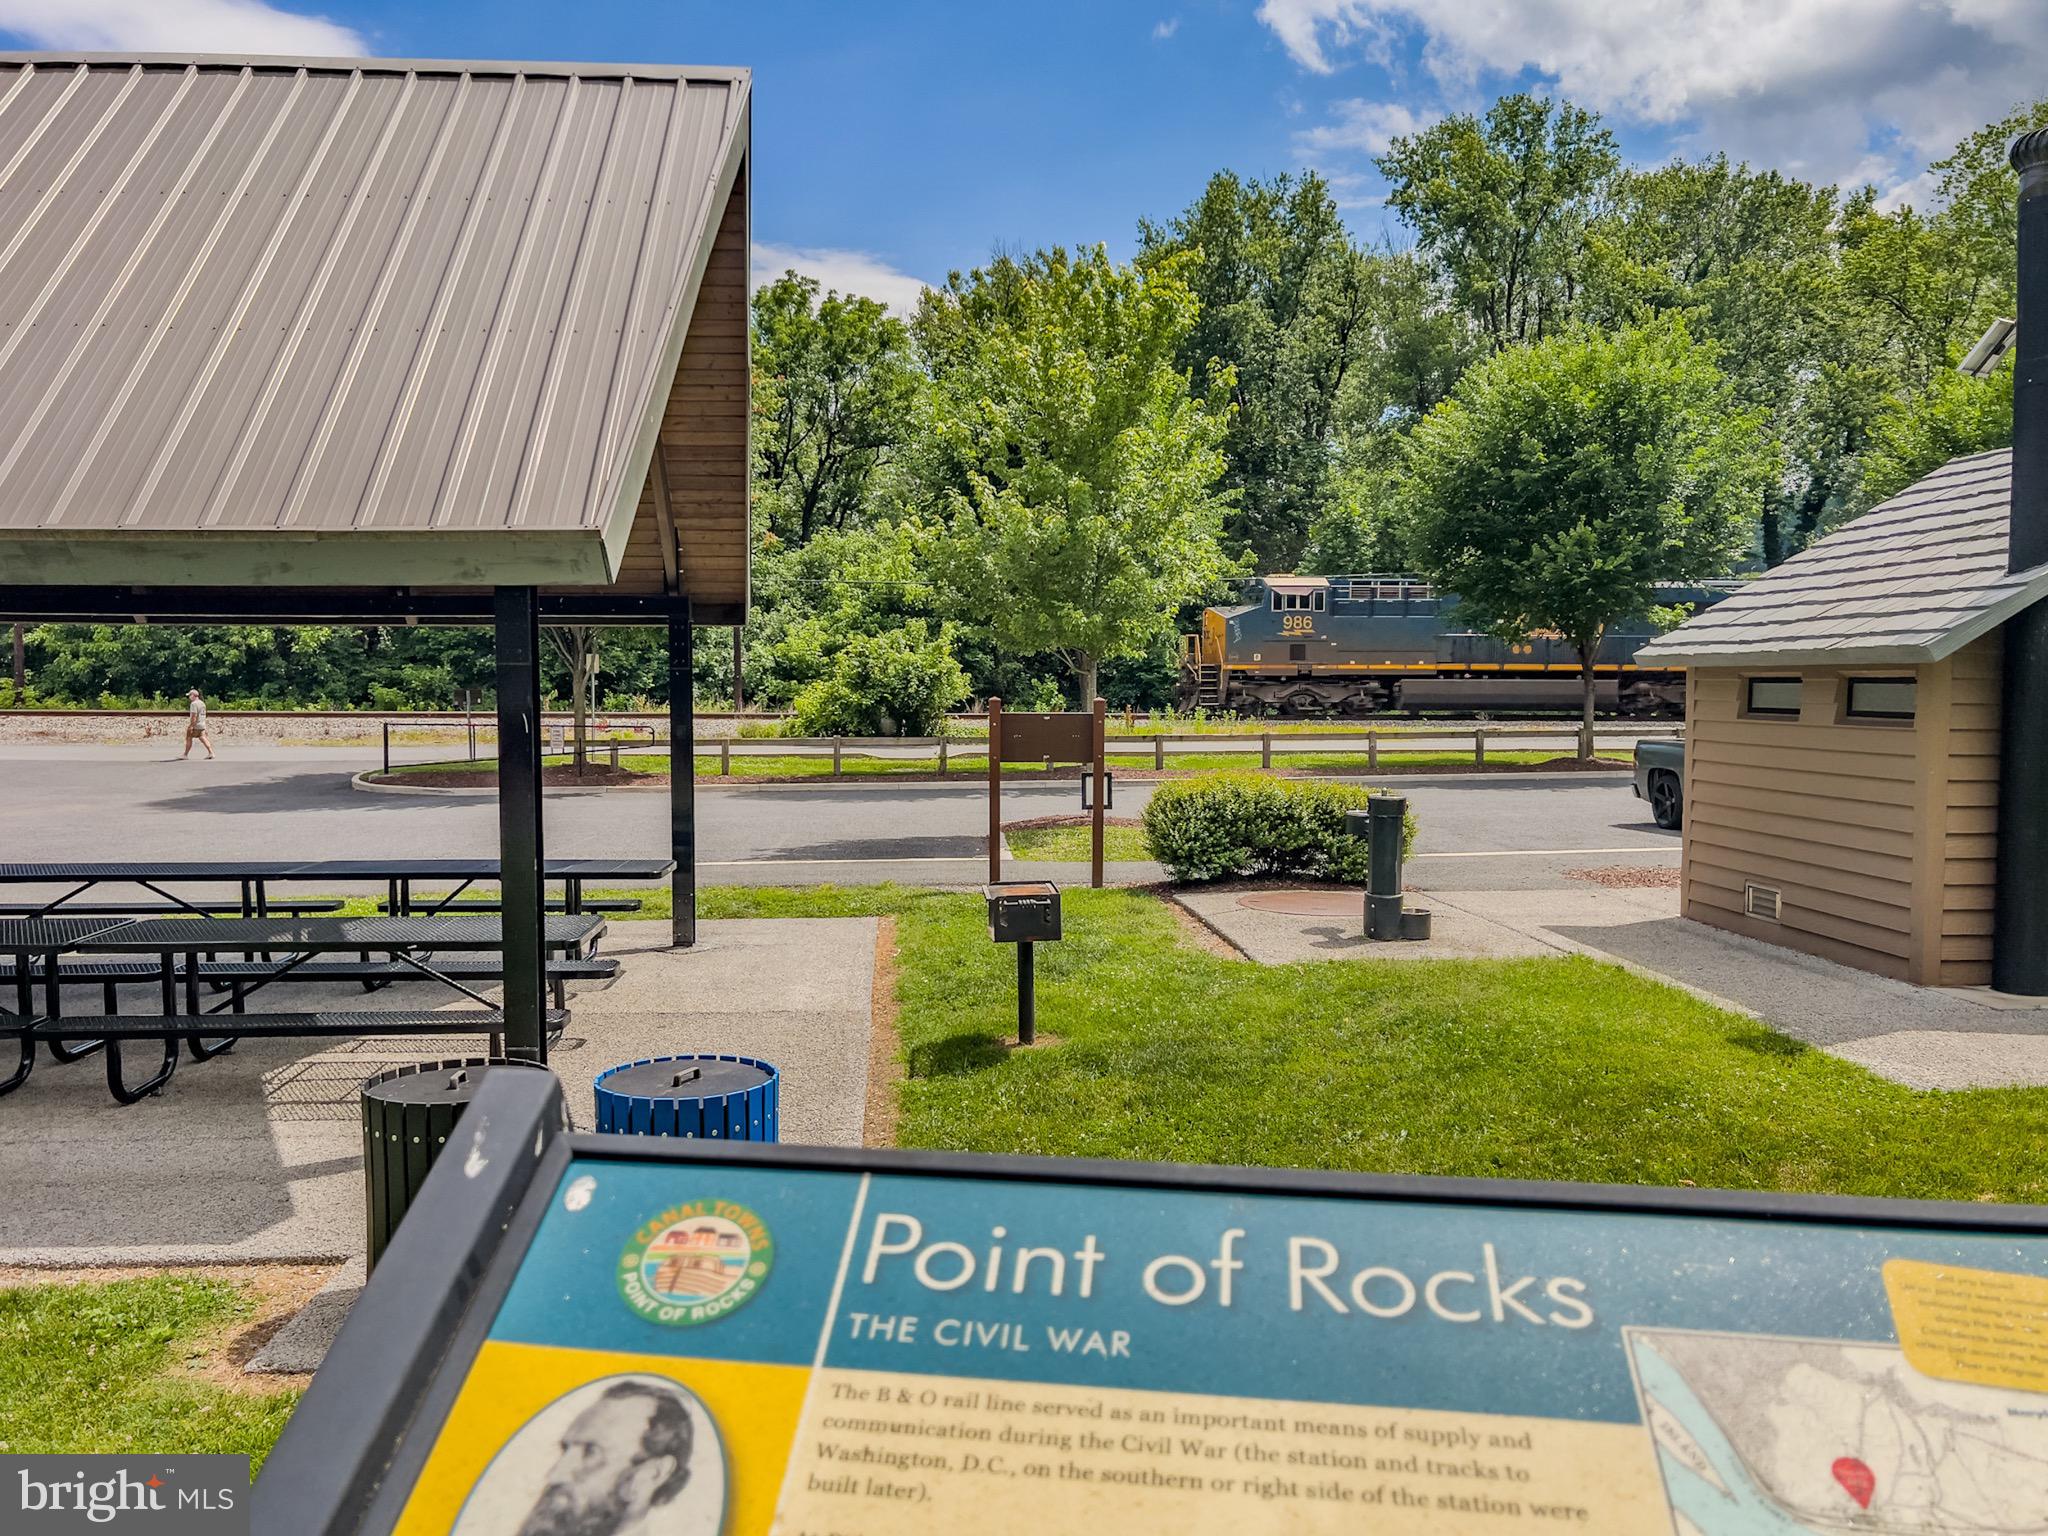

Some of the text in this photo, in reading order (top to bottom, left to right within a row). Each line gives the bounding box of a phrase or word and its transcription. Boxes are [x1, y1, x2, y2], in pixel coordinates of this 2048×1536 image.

[1283, 616, 1312, 629] 986
[636, 1201, 769, 1251] CANAL TOWNS
[861, 1213, 1595, 1328] Point of Rocks
[621, 1272, 756, 1320] POINT OF ROCKS
[849, 1313, 1131, 1358] THE CIVIL WAR
[831, 1383, 1532, 1451] The B & O rail line served as an important means of supply and
[822, 1415, 1530, 1483] communication during the Civil War (the station and tracks to
[807, 1472, 932, 1502] built later).
[816, 1442, 1589, 1521] Washington, D.C., on the southern or right side of the station were
